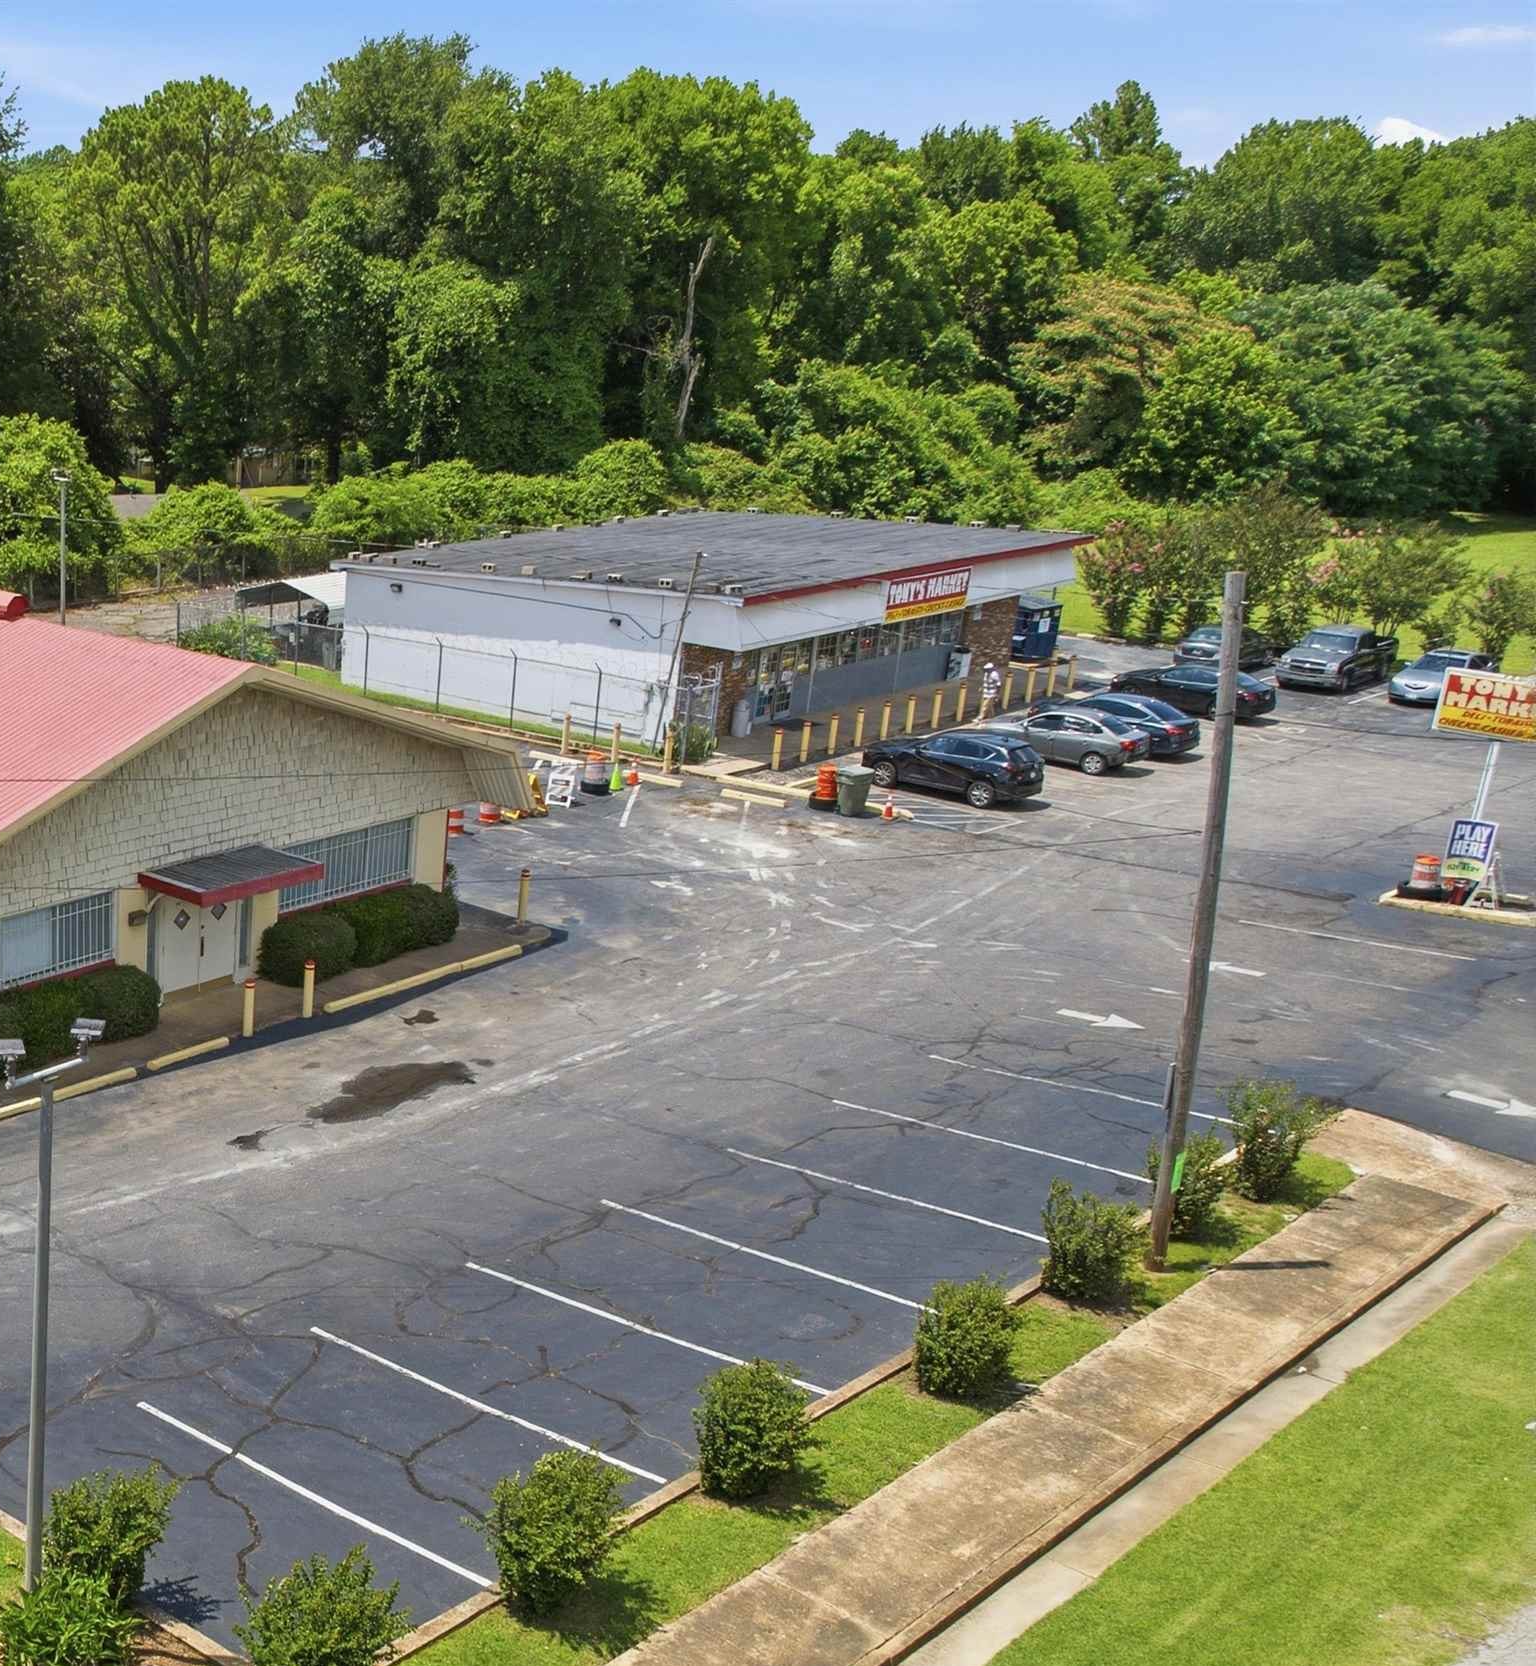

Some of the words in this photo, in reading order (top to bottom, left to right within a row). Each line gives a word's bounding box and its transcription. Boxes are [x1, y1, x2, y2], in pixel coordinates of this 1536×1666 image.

[889, 580, 926, 606] TONY'S
[927, 570, 969, 598] MARKET
[1454, 823, 1493, 842] PLAY
[1450, 841, 1489, 859] HERE
